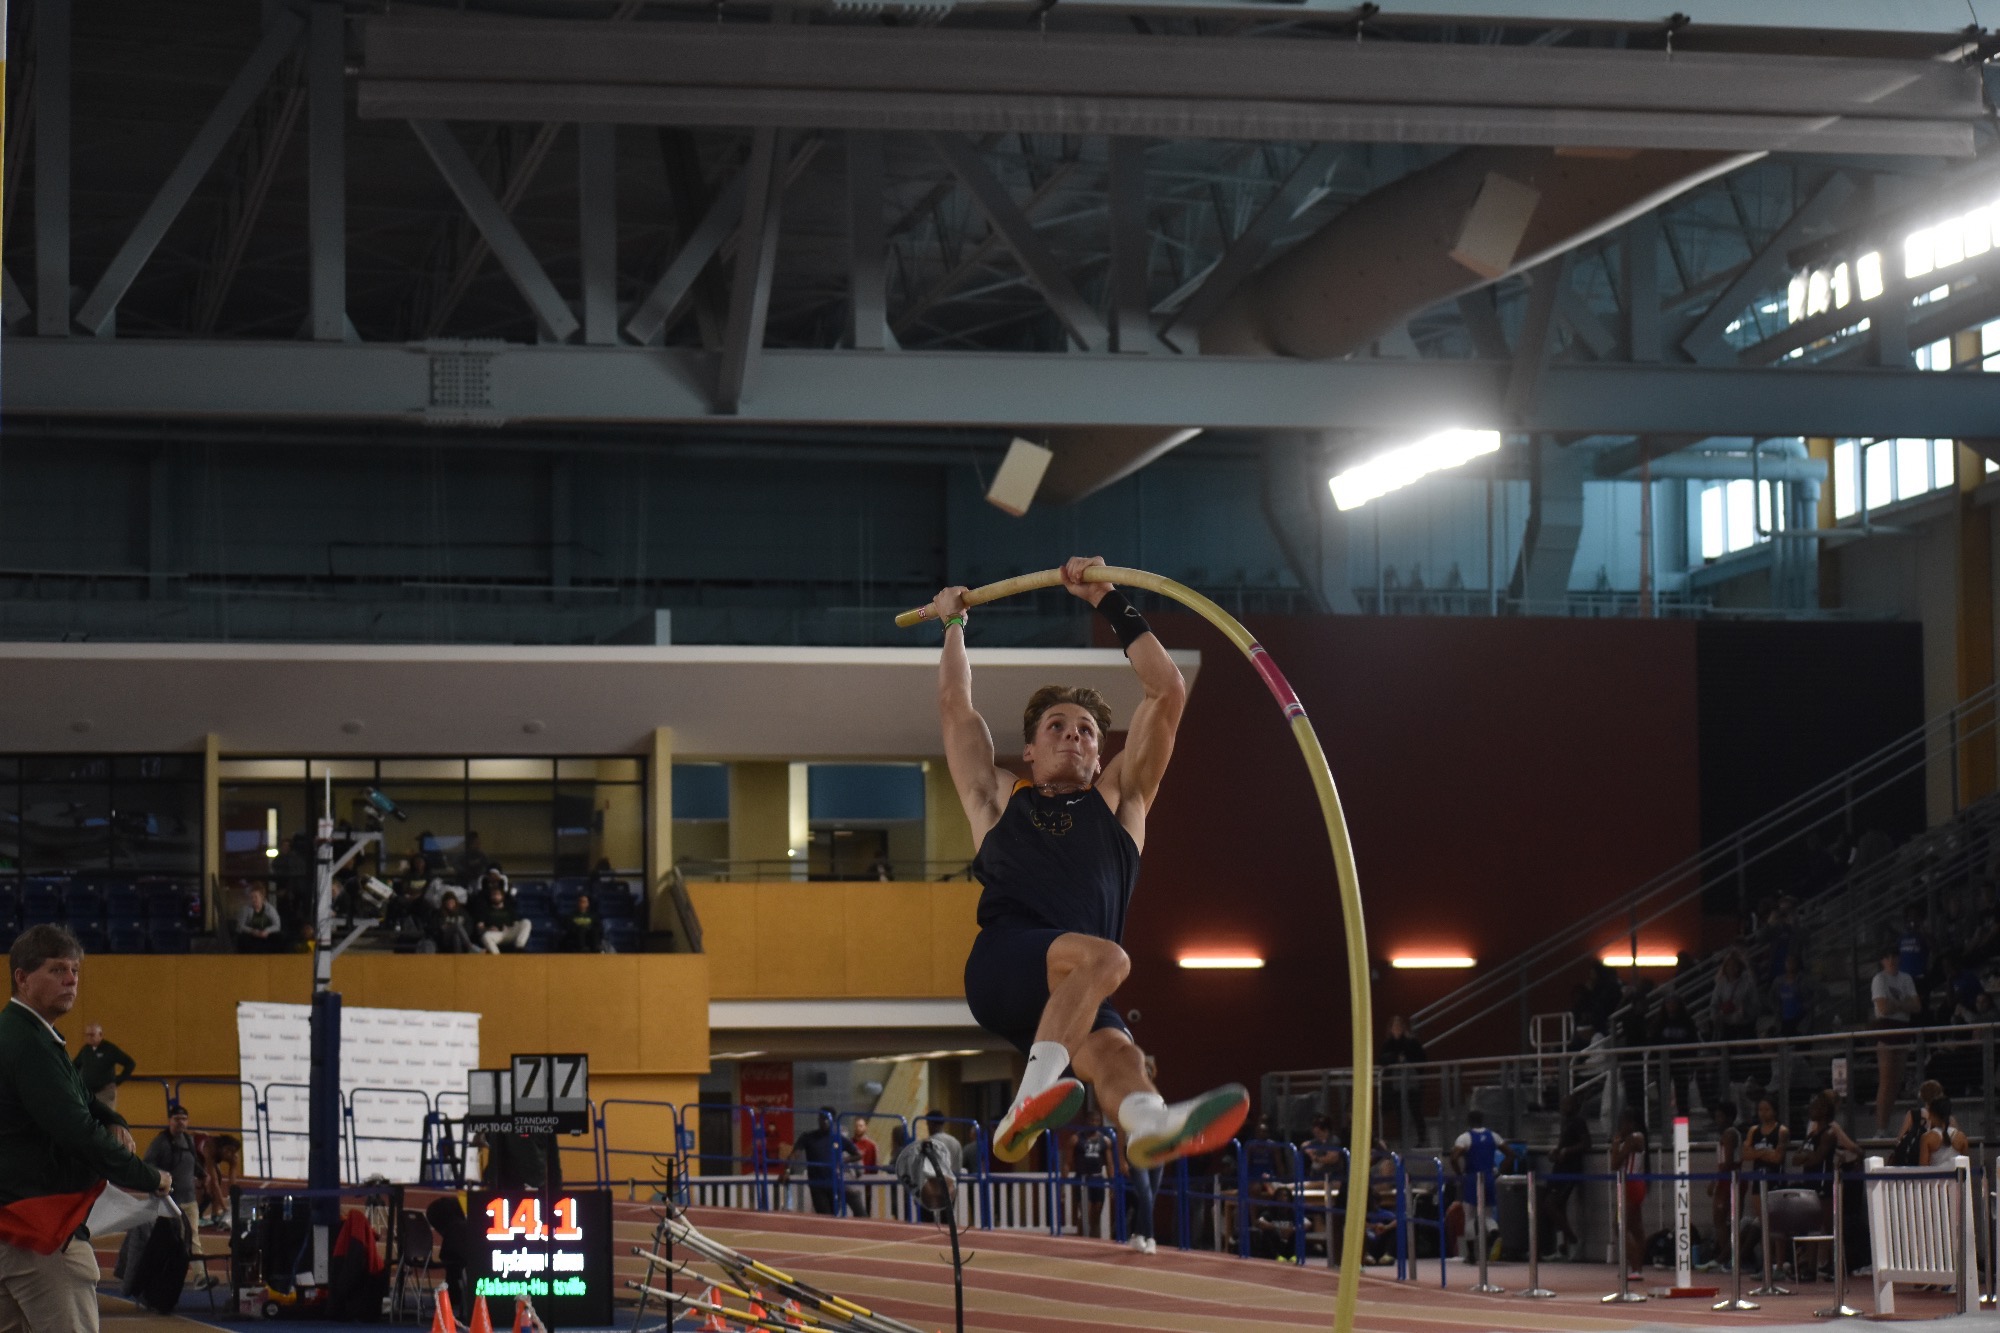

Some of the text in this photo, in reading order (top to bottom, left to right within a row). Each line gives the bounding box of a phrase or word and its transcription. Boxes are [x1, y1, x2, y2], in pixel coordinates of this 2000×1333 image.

[514, 1116, 559, 1125] STANDARD
[469, 1122, 512, 1133] LAPS TO GO
[514, 1125, 554, 1134] SETTINGS
[1677, 1151, 1690, 1271] FINISH
